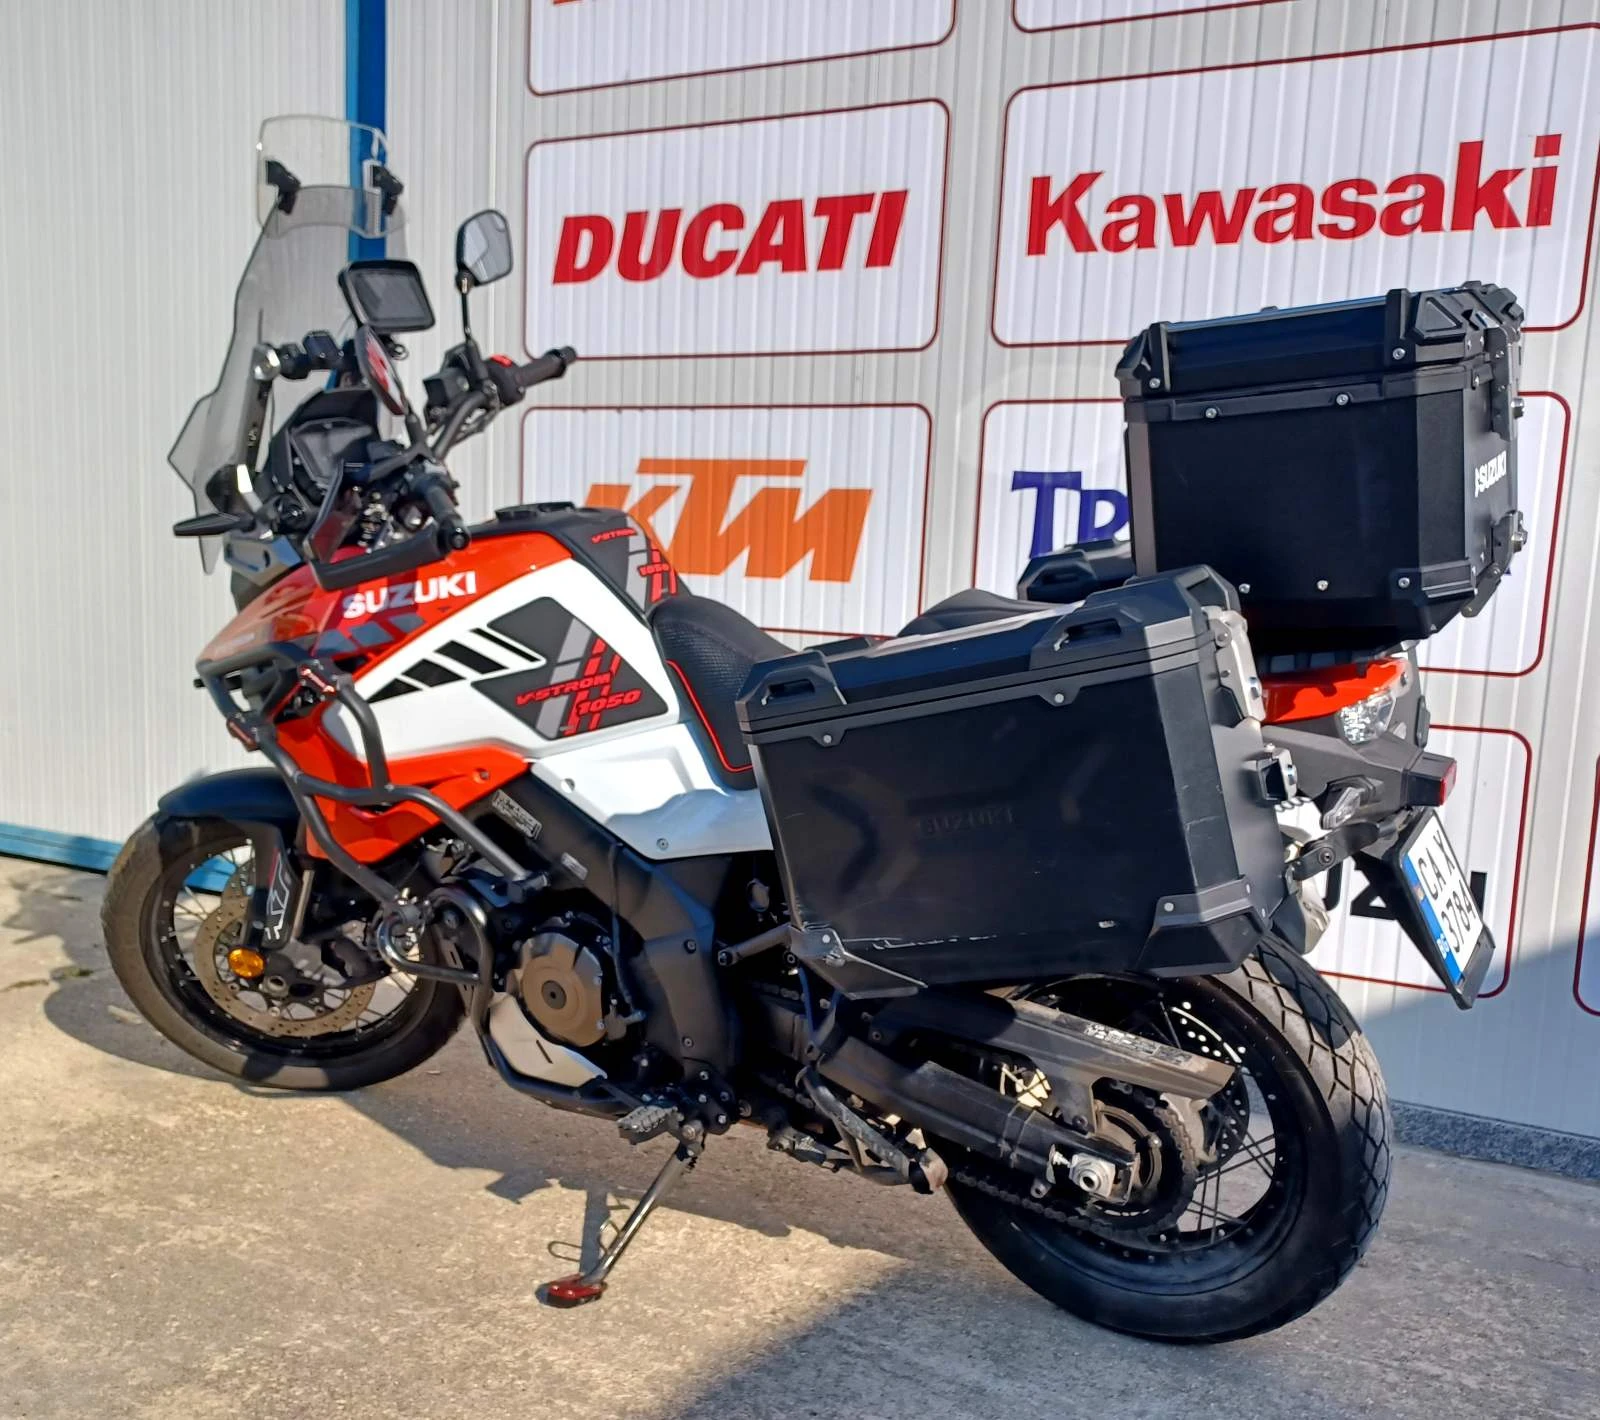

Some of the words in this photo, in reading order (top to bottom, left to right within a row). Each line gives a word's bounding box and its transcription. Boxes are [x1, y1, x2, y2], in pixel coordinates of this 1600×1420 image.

[1026, 133, 1562, 256] Kawasaki
[553, 190, 909, 285] DUCATI
[1479, 449, 1507, 493] SUZUKI
[583, 458, 873, 583] KTM
[342, 570, 477, 619] SUZUKI
[576, 688, 643, 716] 1050
[1418, 847, 1447, 900] CA
[1433, 829, 1456, 875] X
[1441, 880, 1477, 953] 3784
